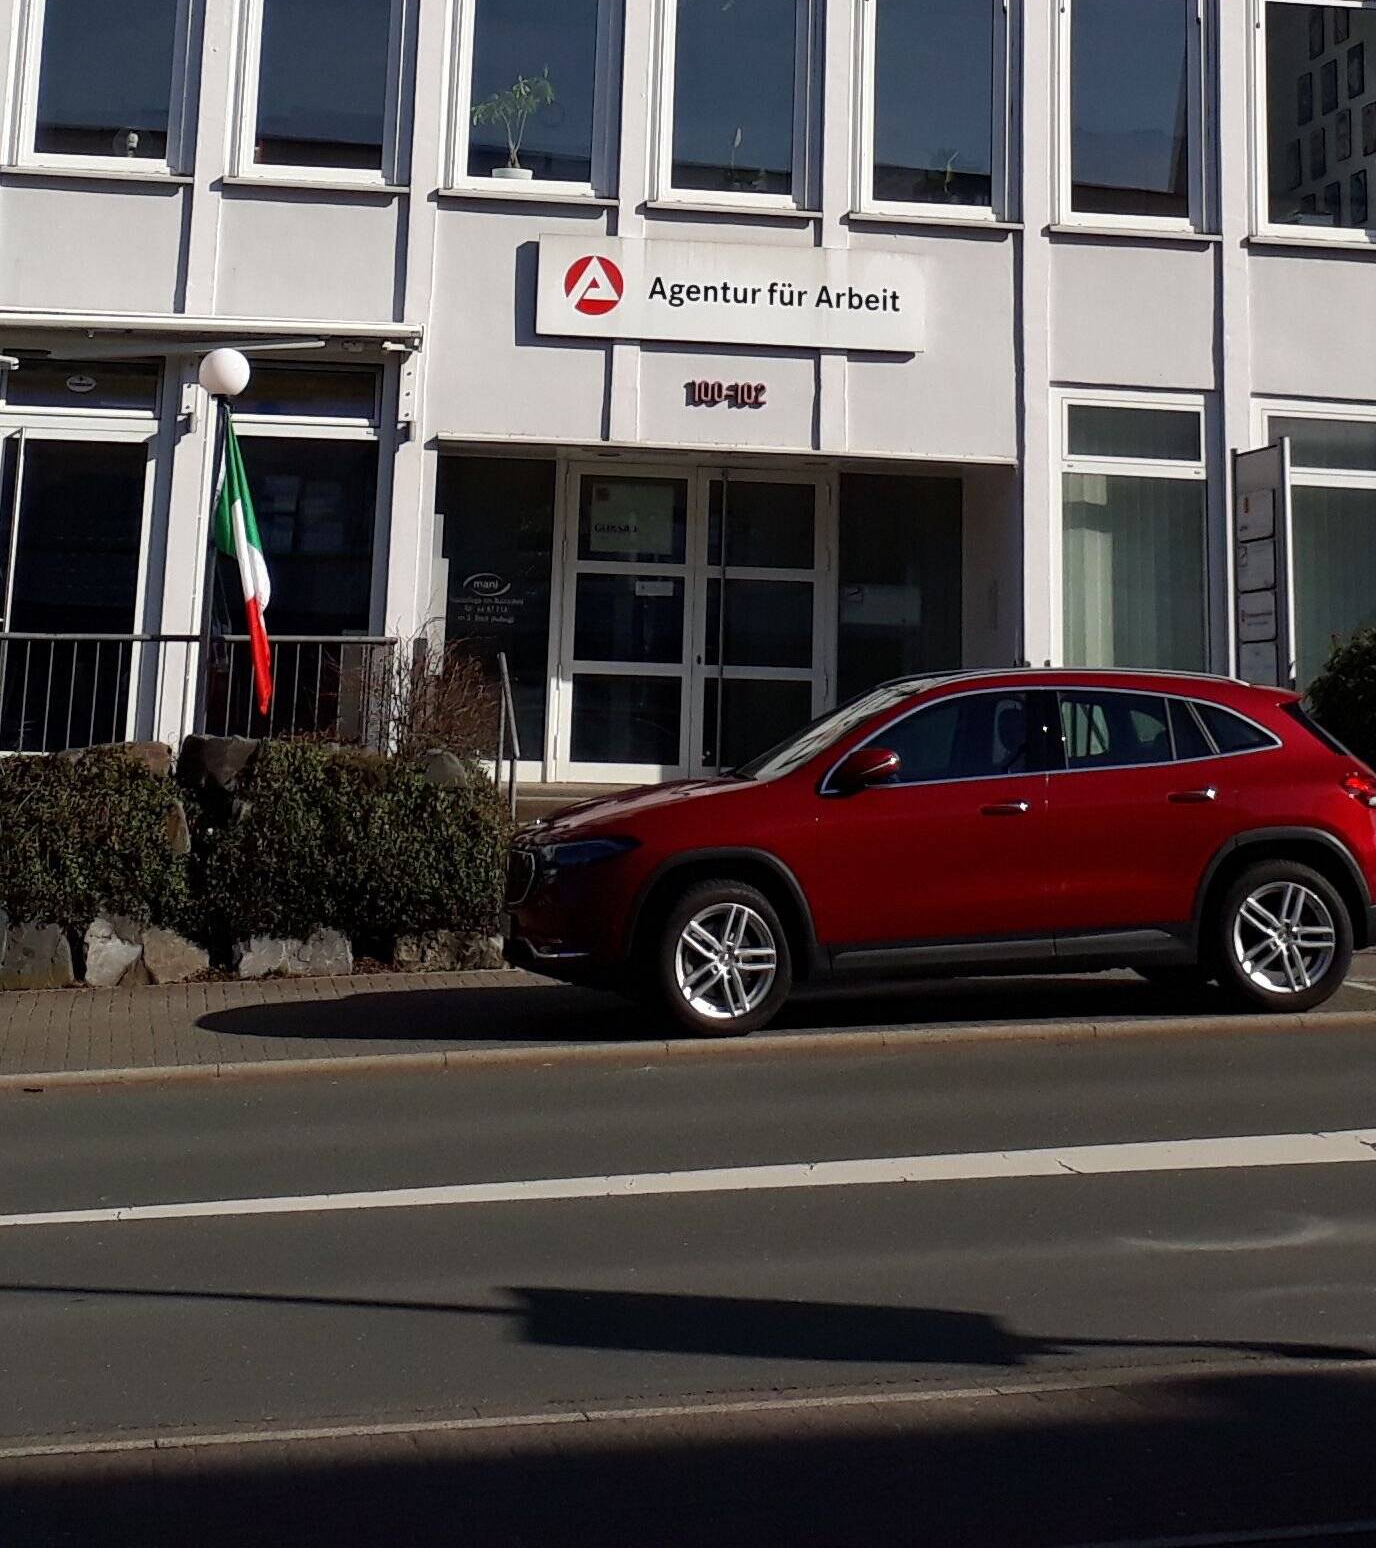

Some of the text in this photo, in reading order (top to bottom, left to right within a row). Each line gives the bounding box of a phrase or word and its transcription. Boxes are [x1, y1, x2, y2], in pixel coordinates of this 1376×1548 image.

[648, 277, 900, 312] Agentur für Arbeit
[687, 379, 767, 406] 100-102
[473, 579, 499, 589] mani
